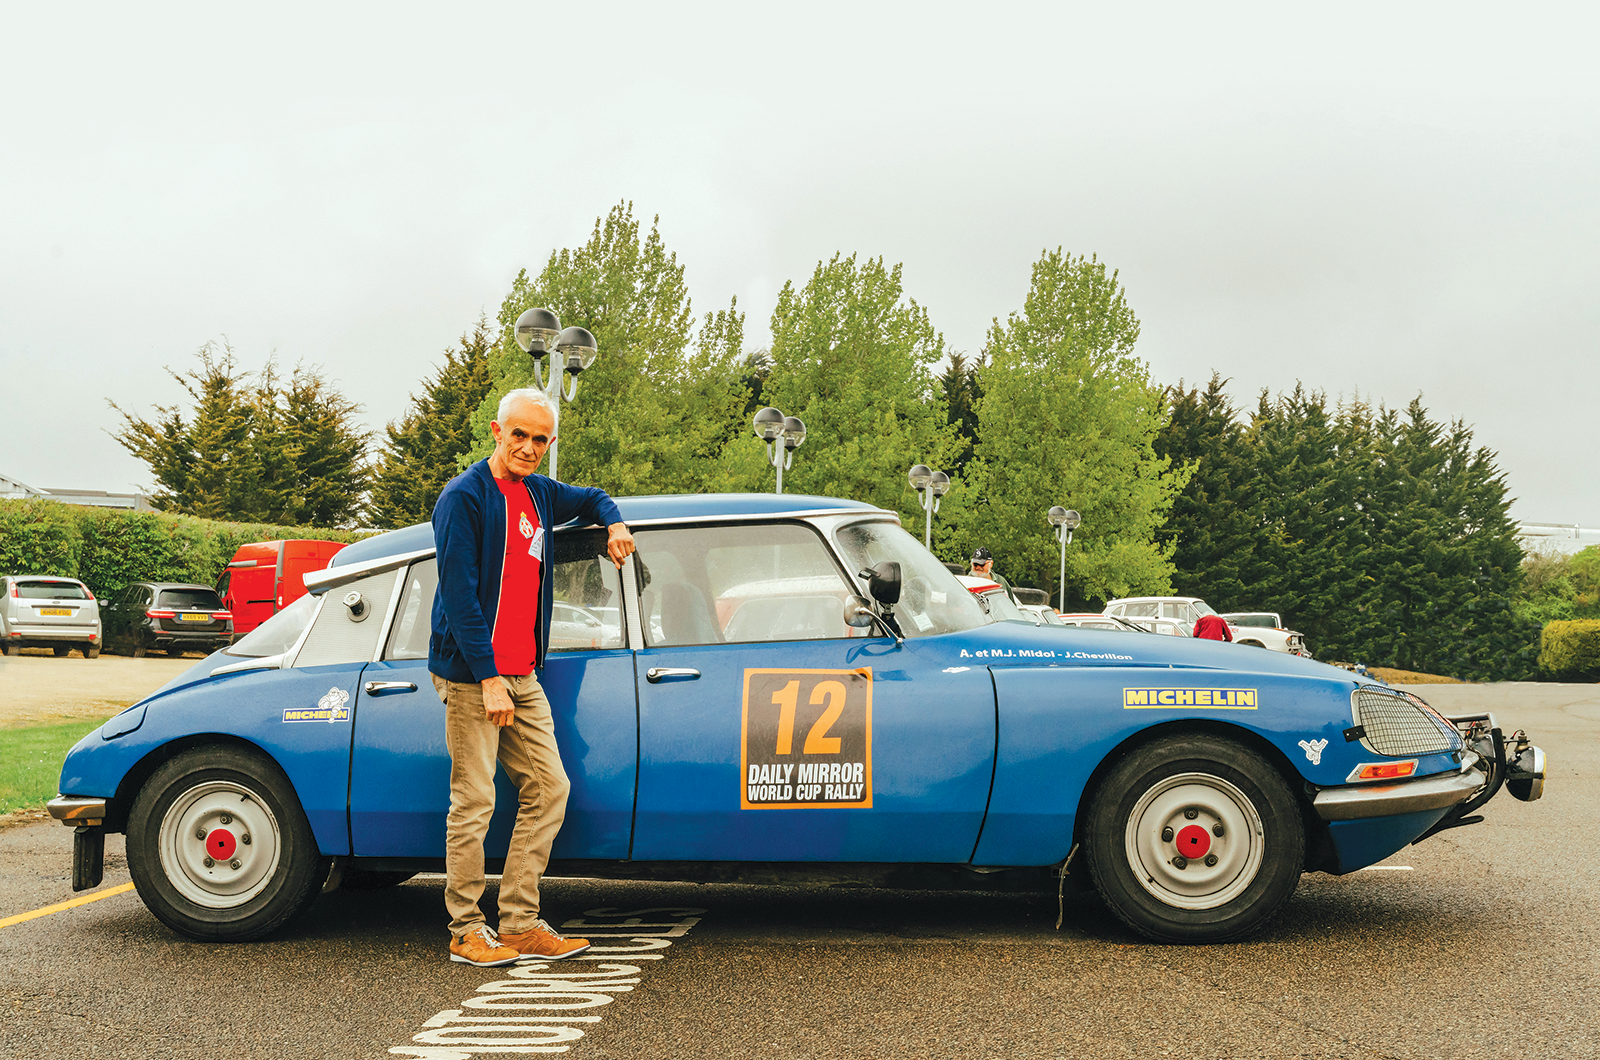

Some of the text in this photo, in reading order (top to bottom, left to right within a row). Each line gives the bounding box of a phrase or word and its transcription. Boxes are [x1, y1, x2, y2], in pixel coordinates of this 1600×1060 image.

[960, 649, 973, 658] A.
[975, 649, 989, 658] et
[991, 649, 1016, 658] M.J.
[1019, 649, 1055, 658] Midol
[1126, 690, 1254, 706] MICHELIN
[285, 710, 347, 720] MICHELN
[771, 680, 847, 755] 12
[748, 763, 864, 784] DAILY MIRROR
[747, 783, 864, 801] WORLD CUP RALLY
